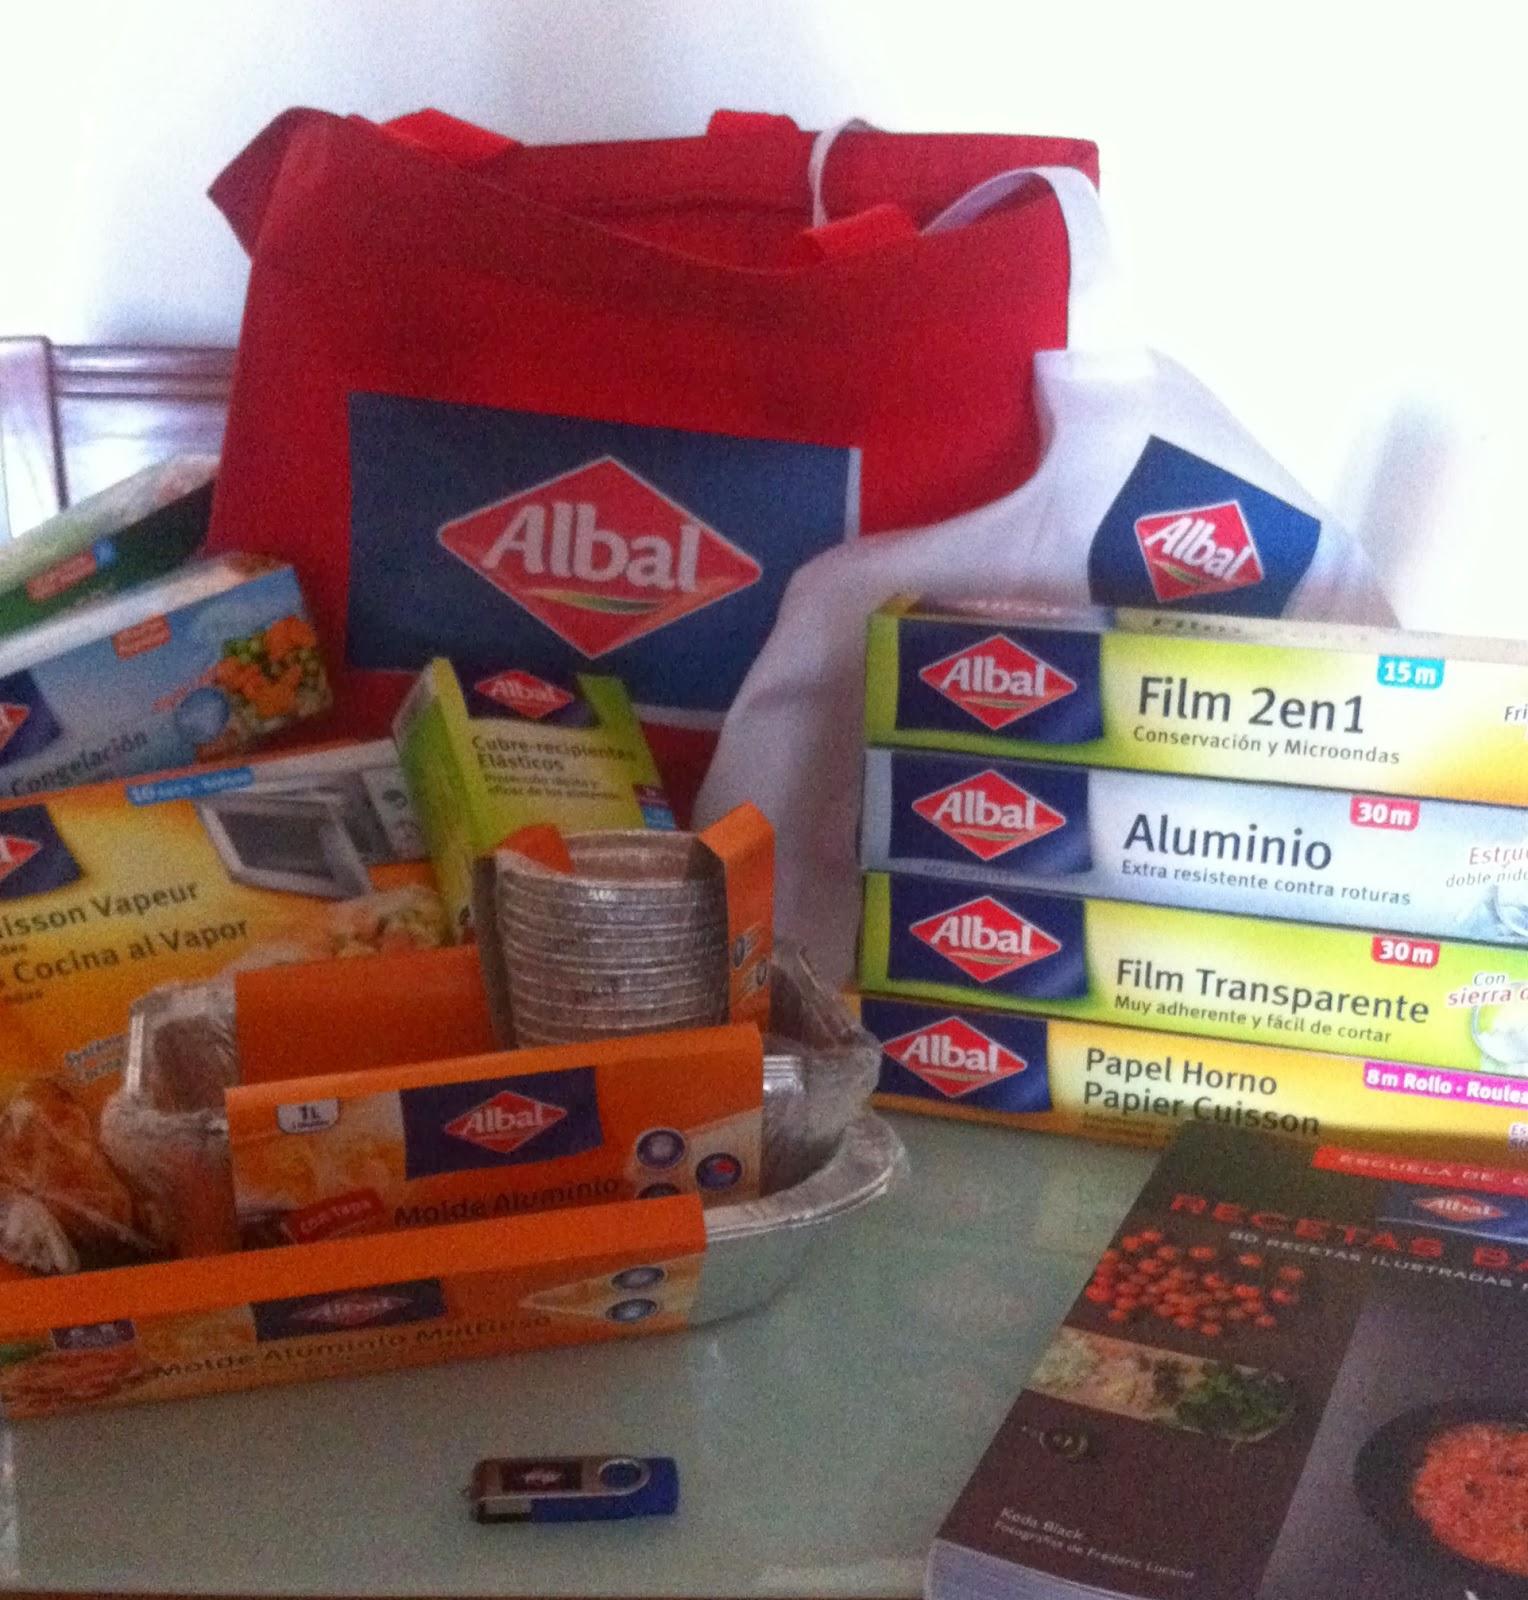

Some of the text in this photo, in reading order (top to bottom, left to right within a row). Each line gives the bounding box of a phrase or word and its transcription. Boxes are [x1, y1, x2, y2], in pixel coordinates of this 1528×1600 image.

[481, 501, 700, 593] Albal
[1144, 517, 1253, 582] Albal
[488, 680, 556, 702] Albal
[940, 656, 1046, 697] Albal
[1383, 662, 1436, 685] 15 m
[1138, 675, 1365, 734] Film 2en1
[1133, 725, 1400, 764] Conservación y Microondas
[931, 789, 1037, 831] Albal
[1357, 803, 1412, 826] 30 m
[1122, 814, 1332, 870] Aluminio
[1122, 859, 1411, 906] Extra resistente contra roturas
[1446, 872, 1491, 888] doble
[0, 882, 197, 938] isson Vapeur
[13, 947, 120, 984] Cocina
[130, 934, 156, 961] al
[159, 919, 247, 952] Vapor
[930, 915, 1033, 956] Albal
[1378, 940, 1433, 963] 30 m
[1116, 958, 1430, 1023] Film Transparente
[1448, 988, 1512, 1006] sierra
[1474, 973, 1506, 986] Con
[1114, 996, 1392, 1044] Muy adherente y fácil de cortar
[900, 1034, 998, 1073] Albal
[1086, 1047, 1278, 1096] Papel Horno
[1403, 1072, 1452, 1095] Rollo
[460, 1103, 543, 1135] Albal
[1083, 1080, 1184, 1117] Papier
[1193, 1096, 1321, 1136] Cuisson
[394, 1179, 618, 1226] Molde Aluminio
[1424, 1198, 1490, 1216] Albal
[1171, 1194, 1442, 1259] RECETAS
[1266, 1239, 1361, 1262] RECETAS
